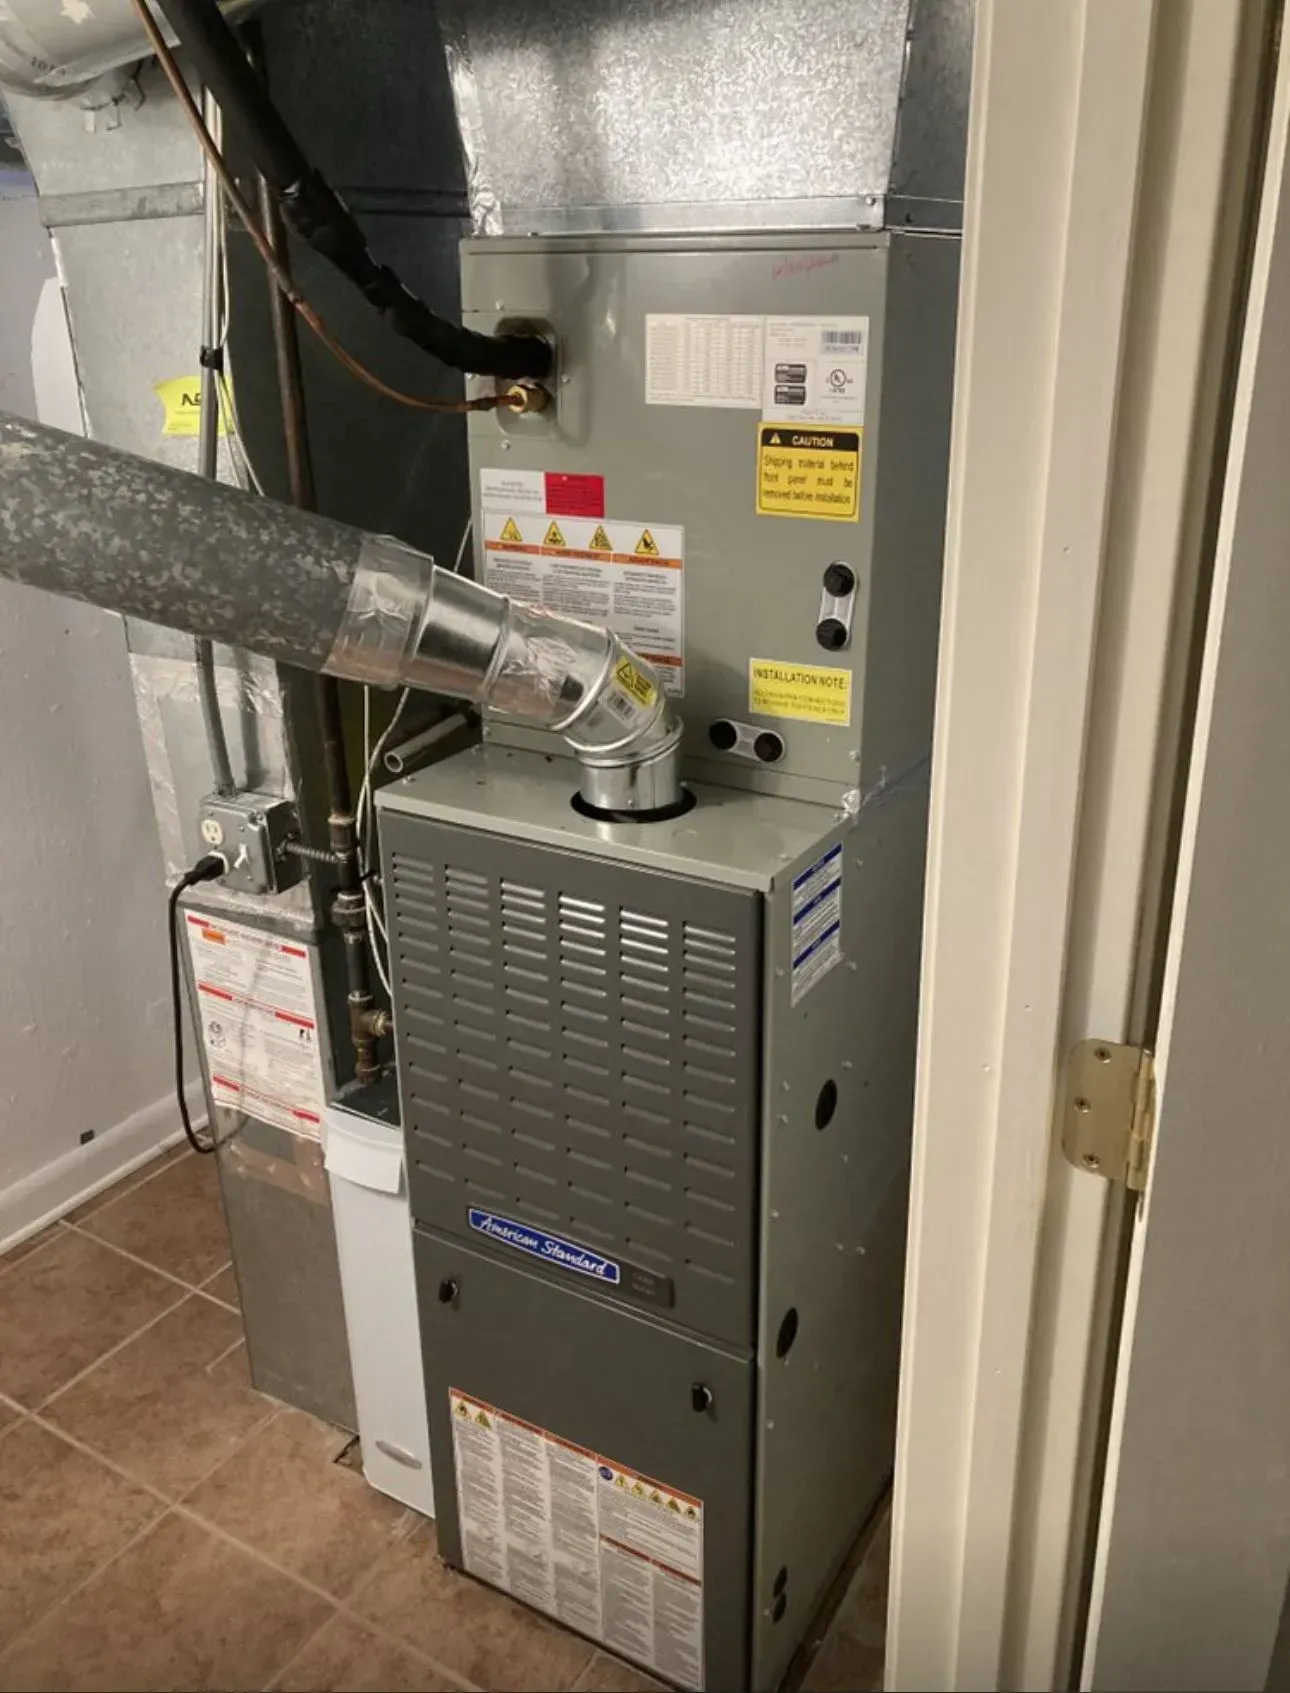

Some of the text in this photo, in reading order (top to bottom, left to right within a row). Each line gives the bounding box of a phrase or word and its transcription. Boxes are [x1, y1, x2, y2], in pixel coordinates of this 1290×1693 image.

[792, 436, 834, 447] CAUTION
[754, 668, 848, 689] INSTALLATION NOTE:
[480, 1216, 606, 1275] American Standard
